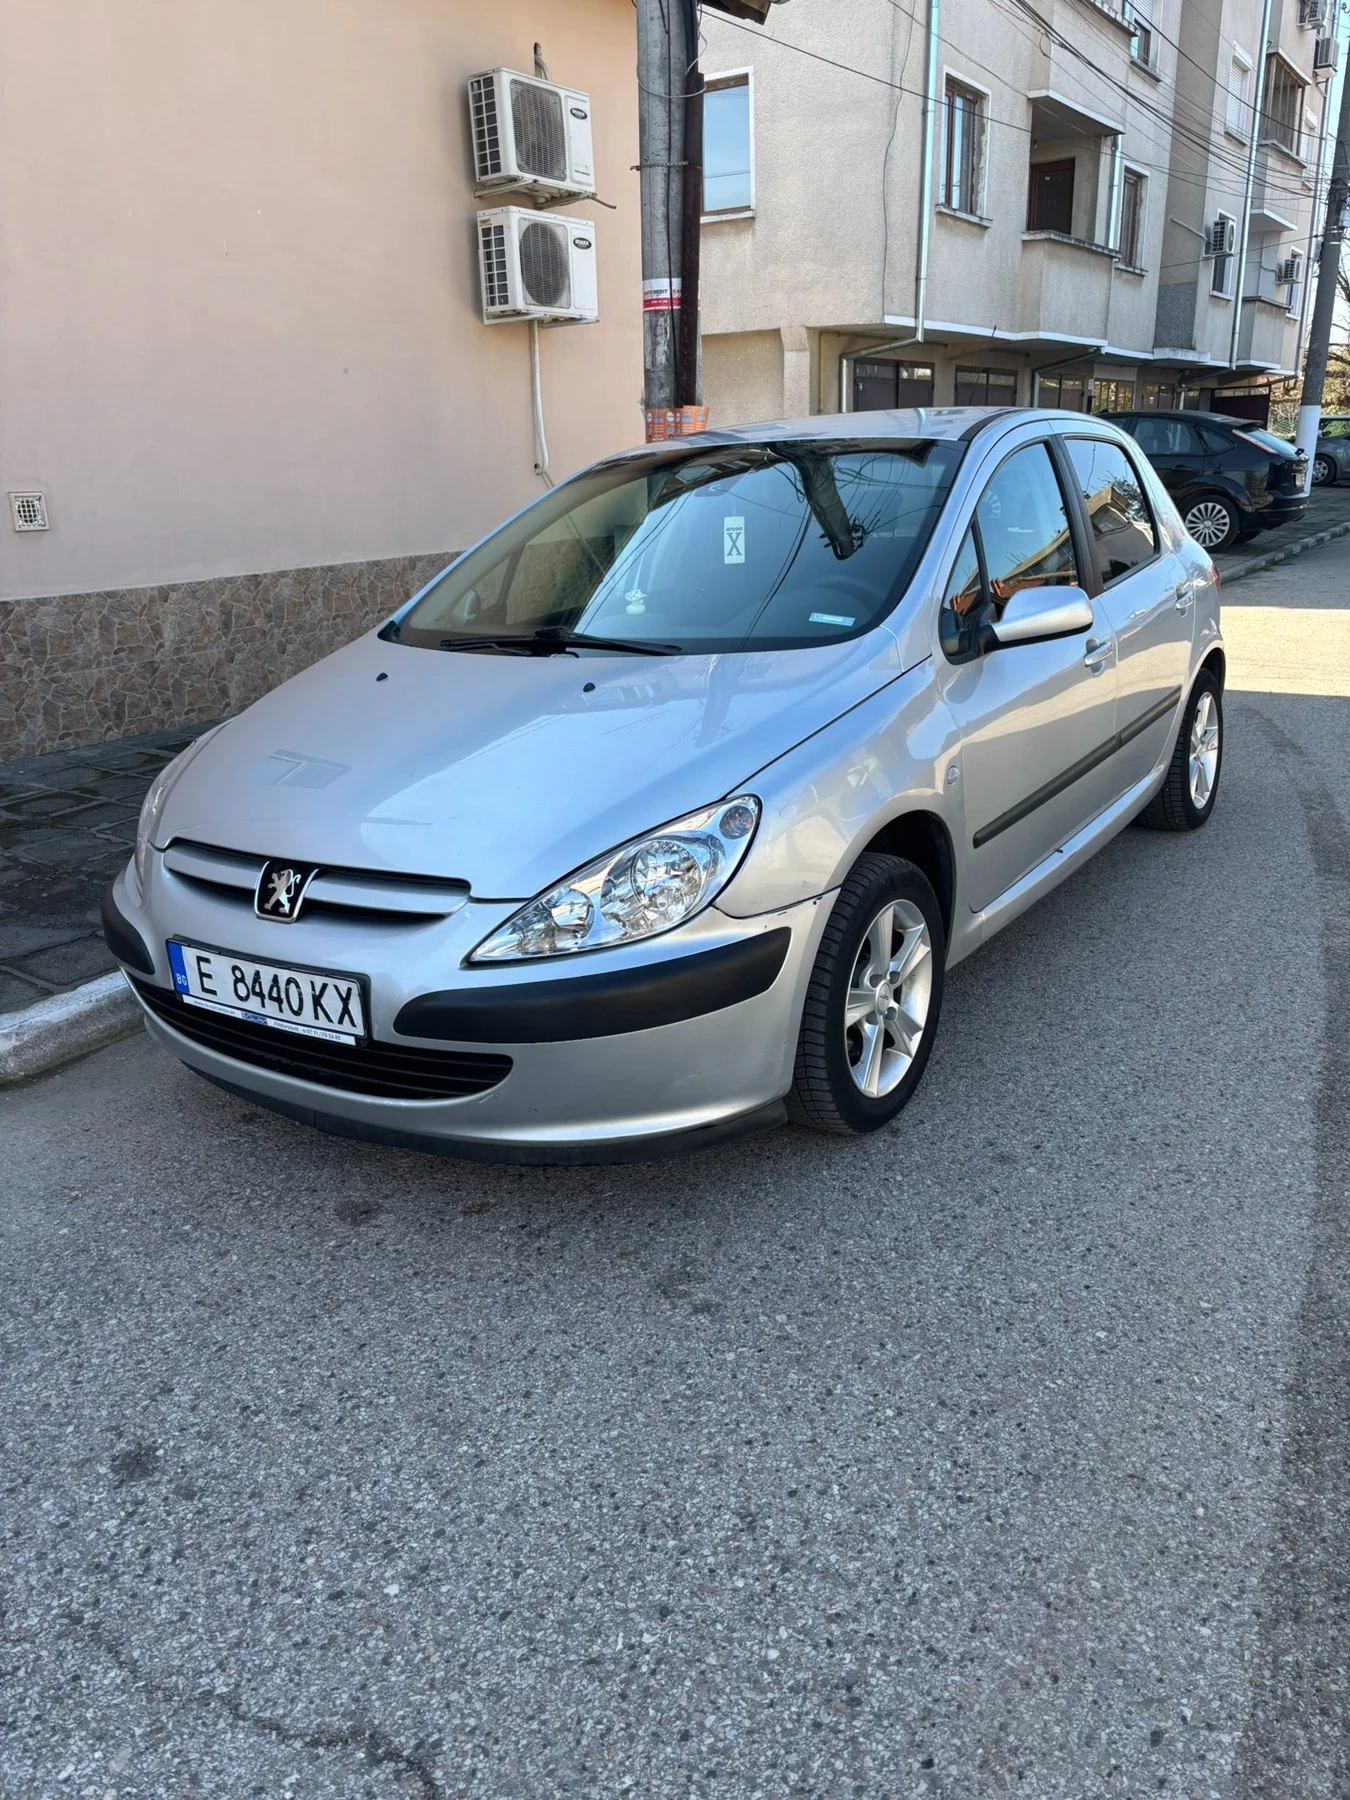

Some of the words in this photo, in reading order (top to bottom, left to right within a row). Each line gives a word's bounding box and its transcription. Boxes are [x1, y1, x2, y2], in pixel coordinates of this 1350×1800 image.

[726, 531, 743, 557] X
[175, 972, 188, 986] BG
[196, 955, 217, 996] E
[231, 964, 304, 1017] 8440
[310, 980, 357, 1028] KX
